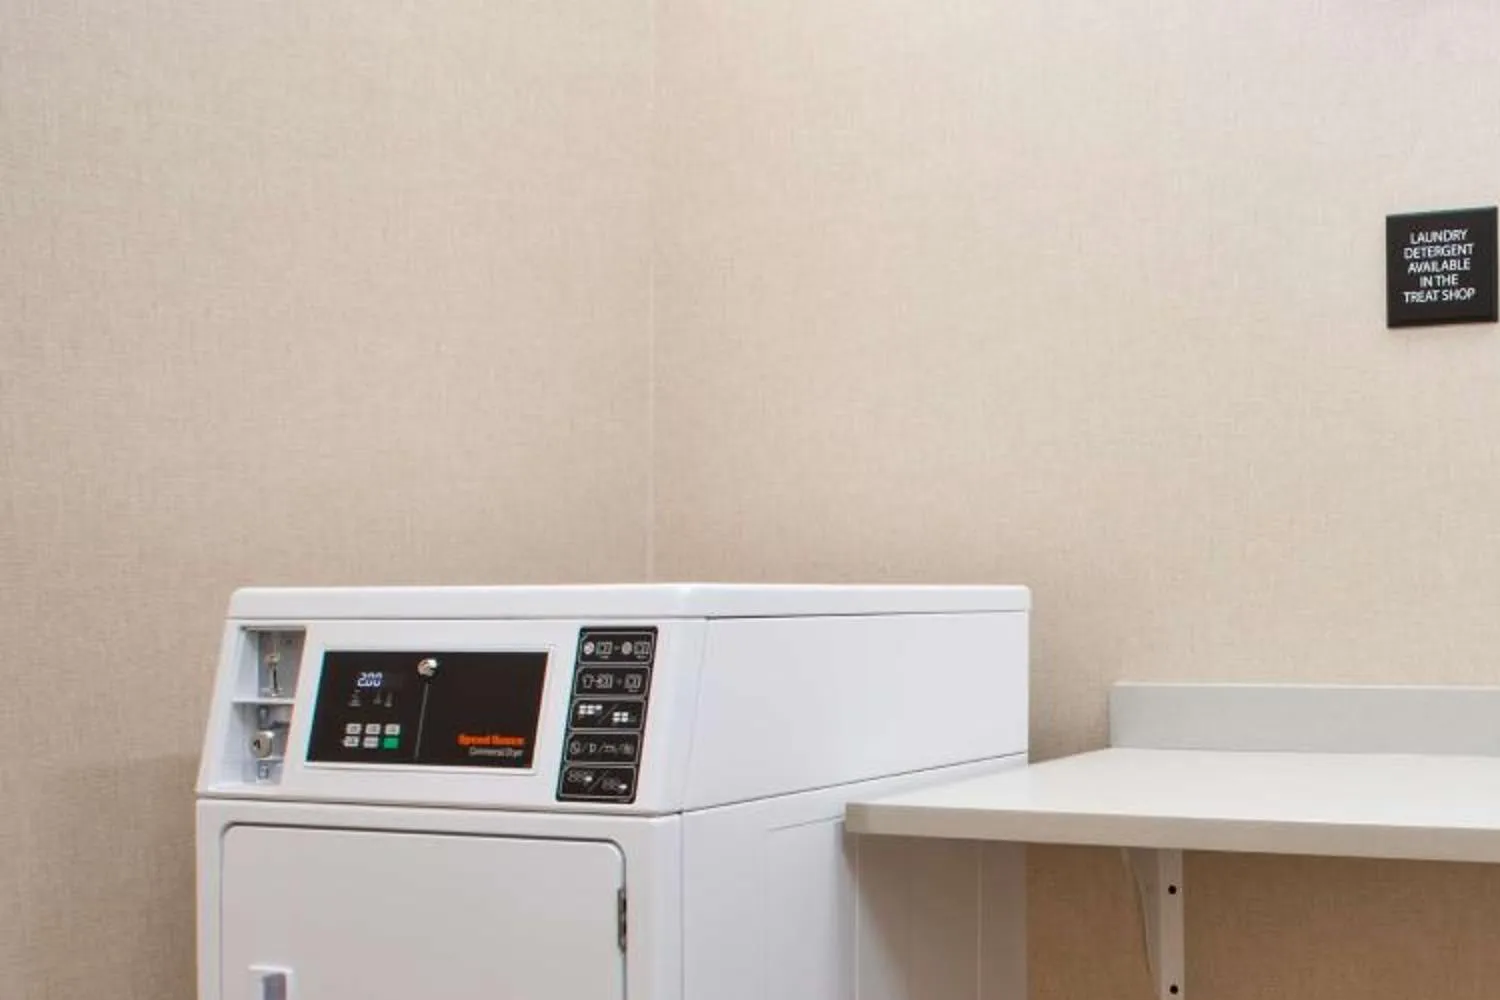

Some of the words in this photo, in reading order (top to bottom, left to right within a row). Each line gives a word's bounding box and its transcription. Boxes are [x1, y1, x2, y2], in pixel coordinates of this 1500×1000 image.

[1410, 229, 1468, 244] LAUNDRY
[1403, 243, 1474, 259] DETERGENT
[1408, 258, 1471, 274] AVAILABLE
[1419, 276, 1433, 287] IN
[1435, 274, 1459, 286] THE
[1403, 290, 1439, 303] TREAT
[1441, 287, 1476, 301] SHOP
